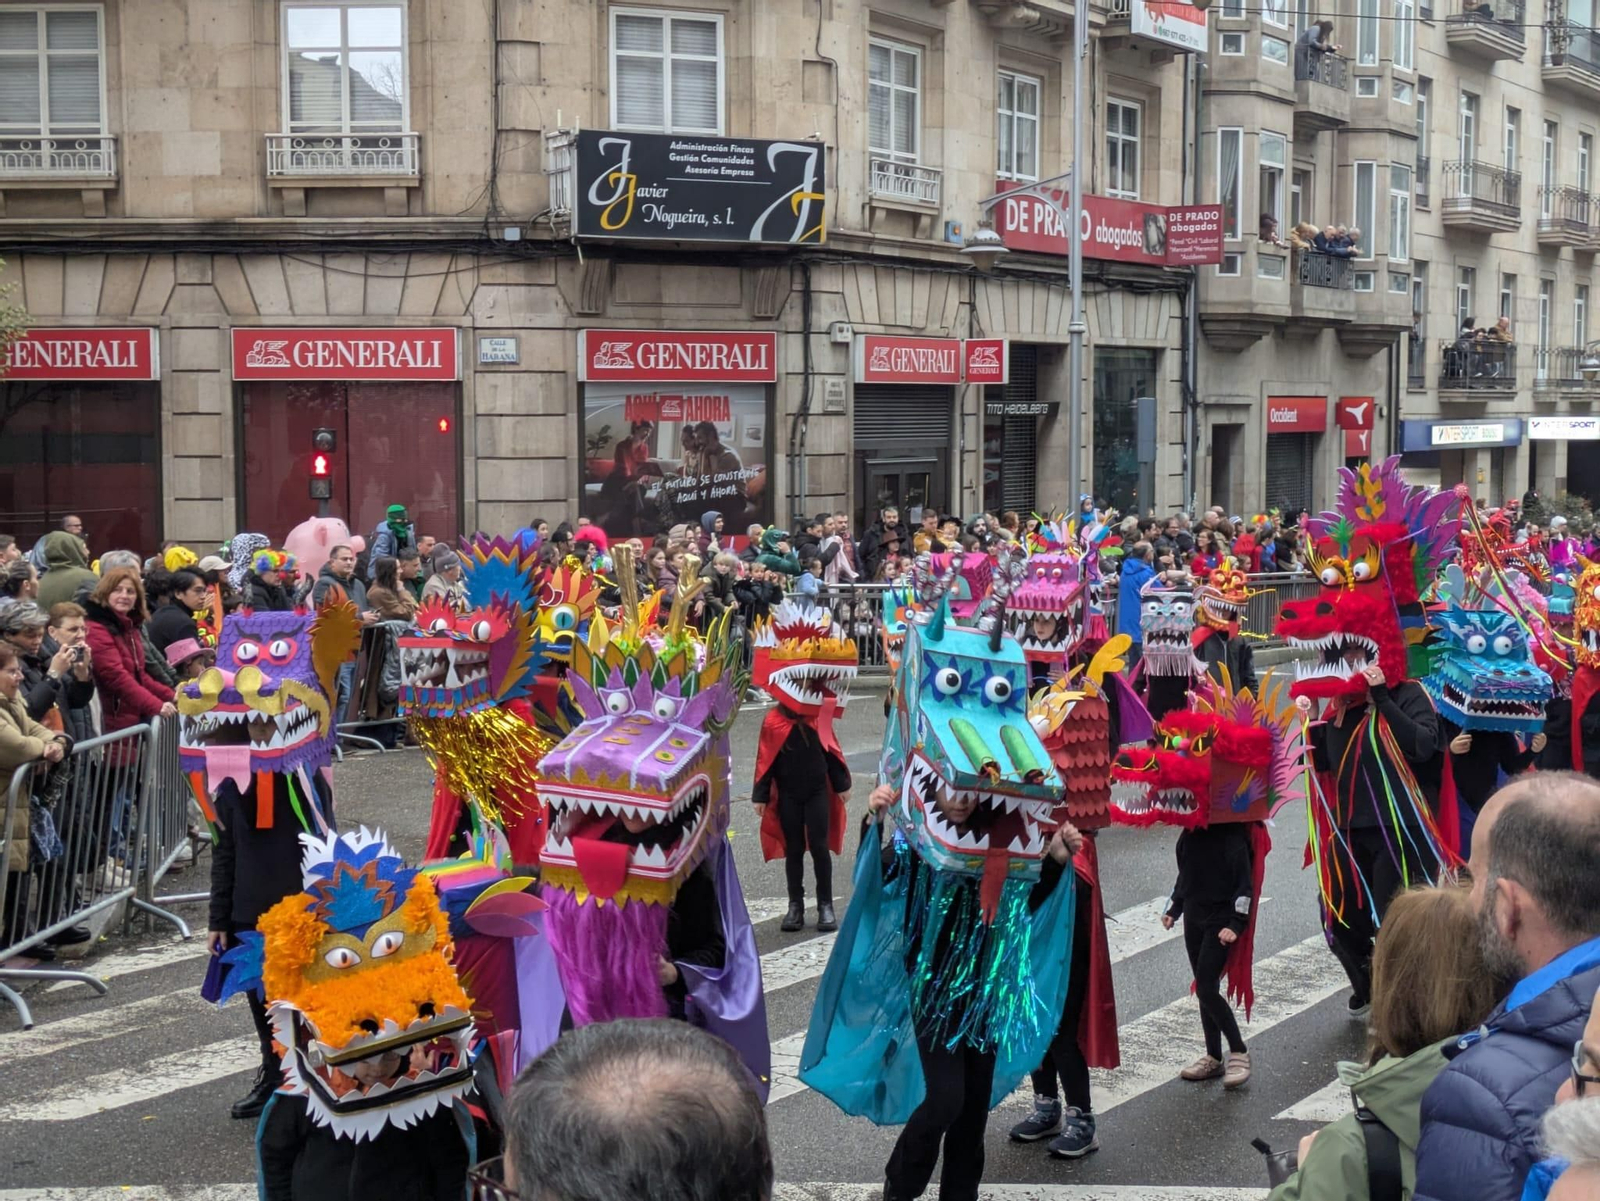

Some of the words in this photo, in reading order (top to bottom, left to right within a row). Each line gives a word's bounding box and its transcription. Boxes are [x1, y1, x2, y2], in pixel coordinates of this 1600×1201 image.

[669, 141, 729, 152] Administración
[730, 144, 755, 154] Fincas
[668, 152, 699, 162] Gestión
[701, 154, 755, 165] Comunidades
[684, 165, 719, 175] Asesoría
[720, 166, 755, 178] Empresa
[641, 203, 709, 230] Nogueira,
[712, 212, 723, 226] s.
[725, 207, 735, 226] l.
[1170, 212, 1182, 222] DE
[1186, 211, 1219, 221] PRADO
[1005, 199, 1029, 233] DE
[1034, 202, 1092, 241] PRAO
[1095, 217, 1143, 251] abogados
[1171, 221, 1218, 233] abogados
[293, 340, 442, 368] GENERALI
[482, 352, 516, 361] HABANA
[636, 342, 768, 370] GENERALI
[891, 347, 956, 373] GENERALI
[969, 367, 1000, 375] GENERALI
[686, 395, 731, 422] AHORA
[987, 403, 1003, 415] TITO
[1270, 408, 1298, 423] Occident
[651, 480, 664, 492] EL
[665, 475, 697, 490] FUTURO
[700, 474, 711, 487] SE
[713, 467, 761, 484] CONSTRUYE
[676, 489, 698, 504] AQUÍ
[701, 489, 708, 500] Y
